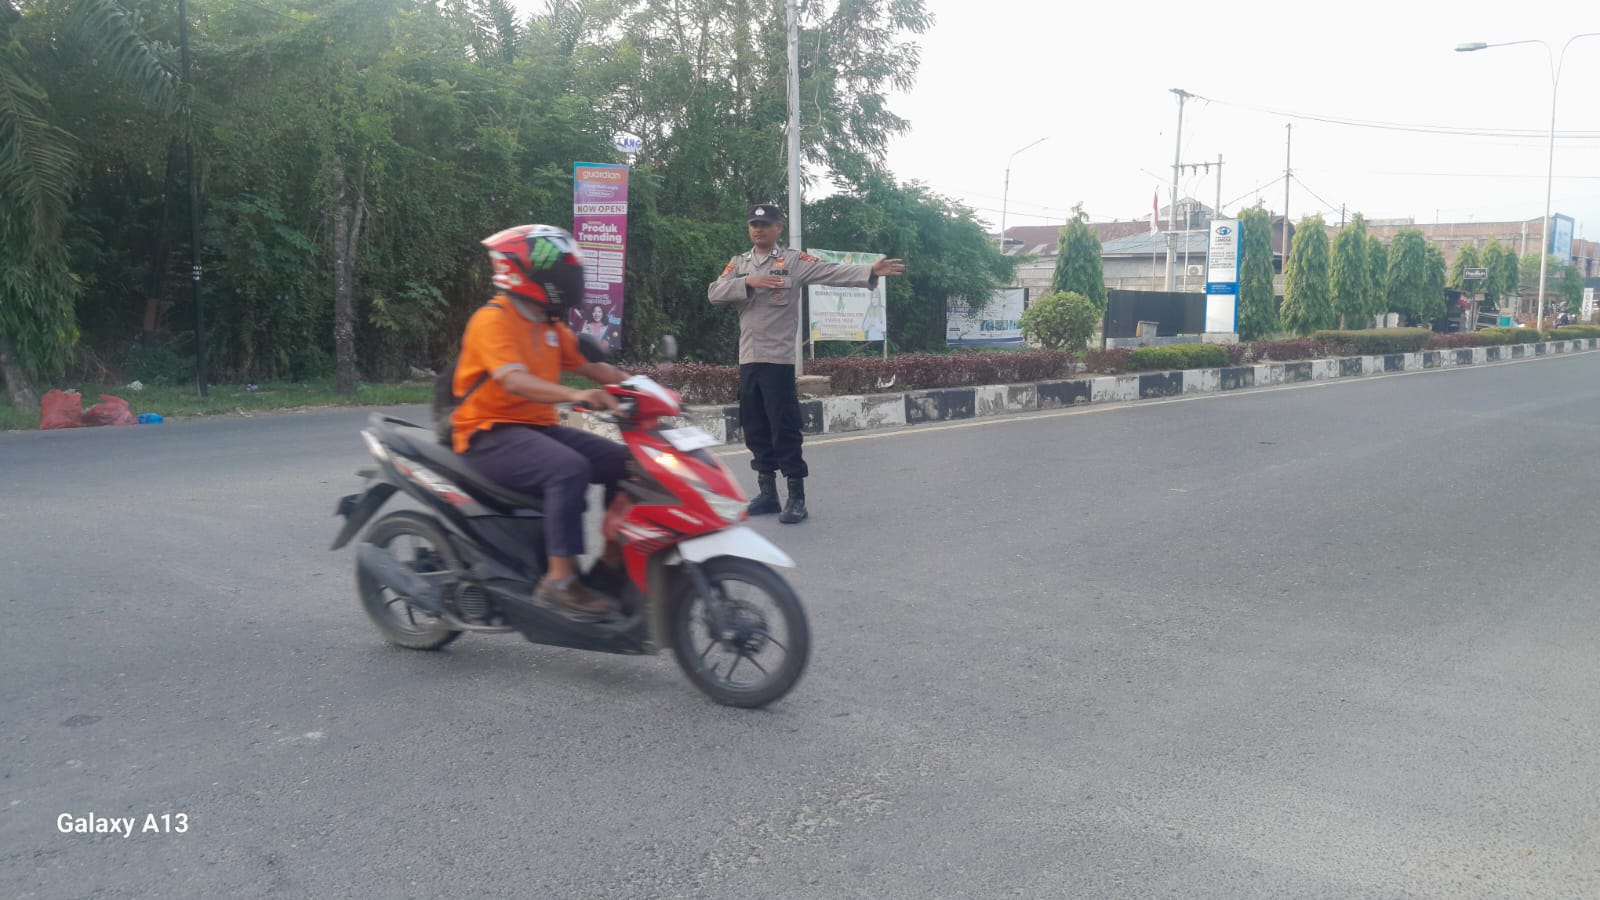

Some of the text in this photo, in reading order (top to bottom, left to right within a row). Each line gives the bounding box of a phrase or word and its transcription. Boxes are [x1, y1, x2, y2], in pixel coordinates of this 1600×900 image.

[582, 170, 621, 179] guardian
[577, 205, 625, 213] NOW OPEN!
[581, 223, 618, 233] Produk
[578, 232, 622, 244] Trending
